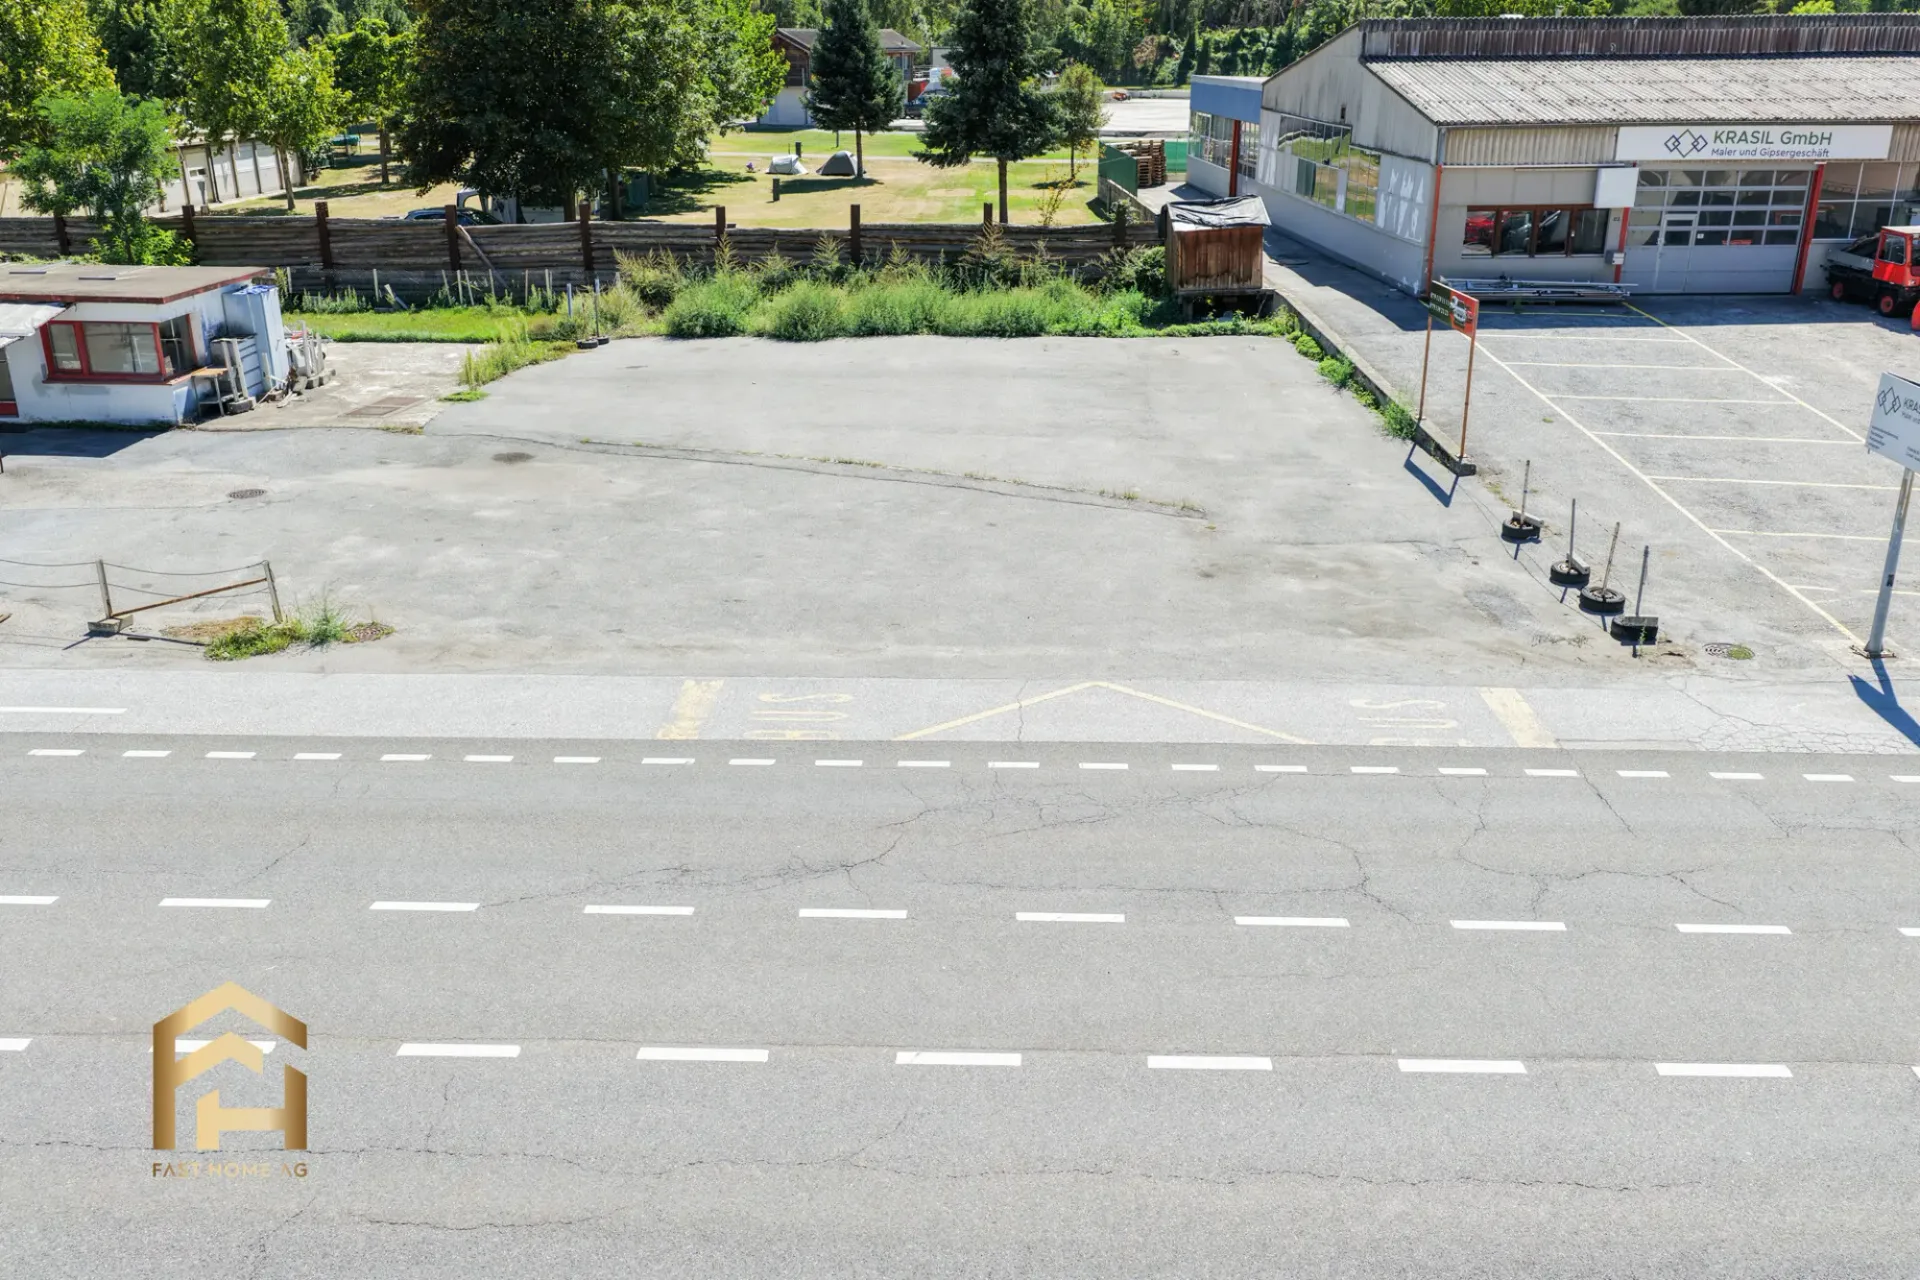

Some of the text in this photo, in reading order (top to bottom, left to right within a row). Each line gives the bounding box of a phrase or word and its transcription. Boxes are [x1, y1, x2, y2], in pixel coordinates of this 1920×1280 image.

[1713, 130, 1833, 146] KRASIL GmbH
[1711, 147, 1830, 159] Maler und Gipsergeschäft
[1903, 397, 1920, 415] KRA
